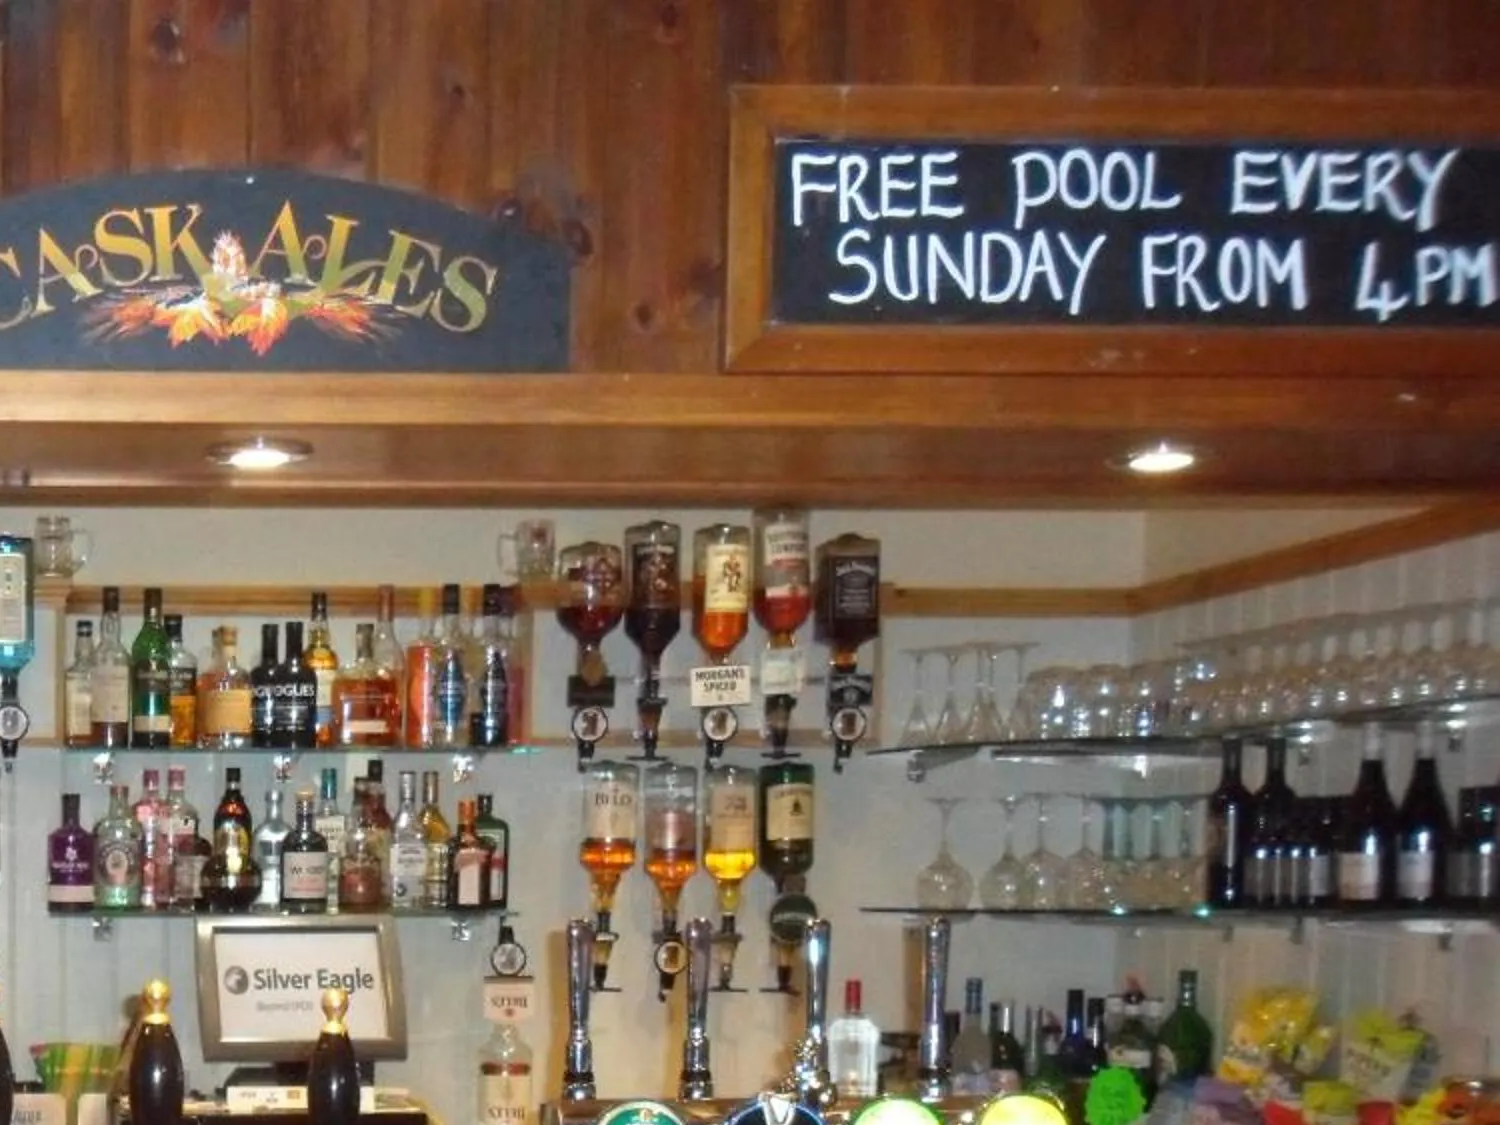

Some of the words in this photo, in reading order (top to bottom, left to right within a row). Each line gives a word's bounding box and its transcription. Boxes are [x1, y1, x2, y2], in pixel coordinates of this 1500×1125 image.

[791, 151, 964, 226] FREE
[1012, 150, 1182, 229] POOL
[1230, 147, 1460, 232] EVERY
[248, 200, 498, 332] ALES
[829, 230, 1107, 315] SUNDAY
[1141, 234, 1308, 312] FROM
[253, 968, 311, 990] Silver
[317, 967, 374, 995] Eagle
